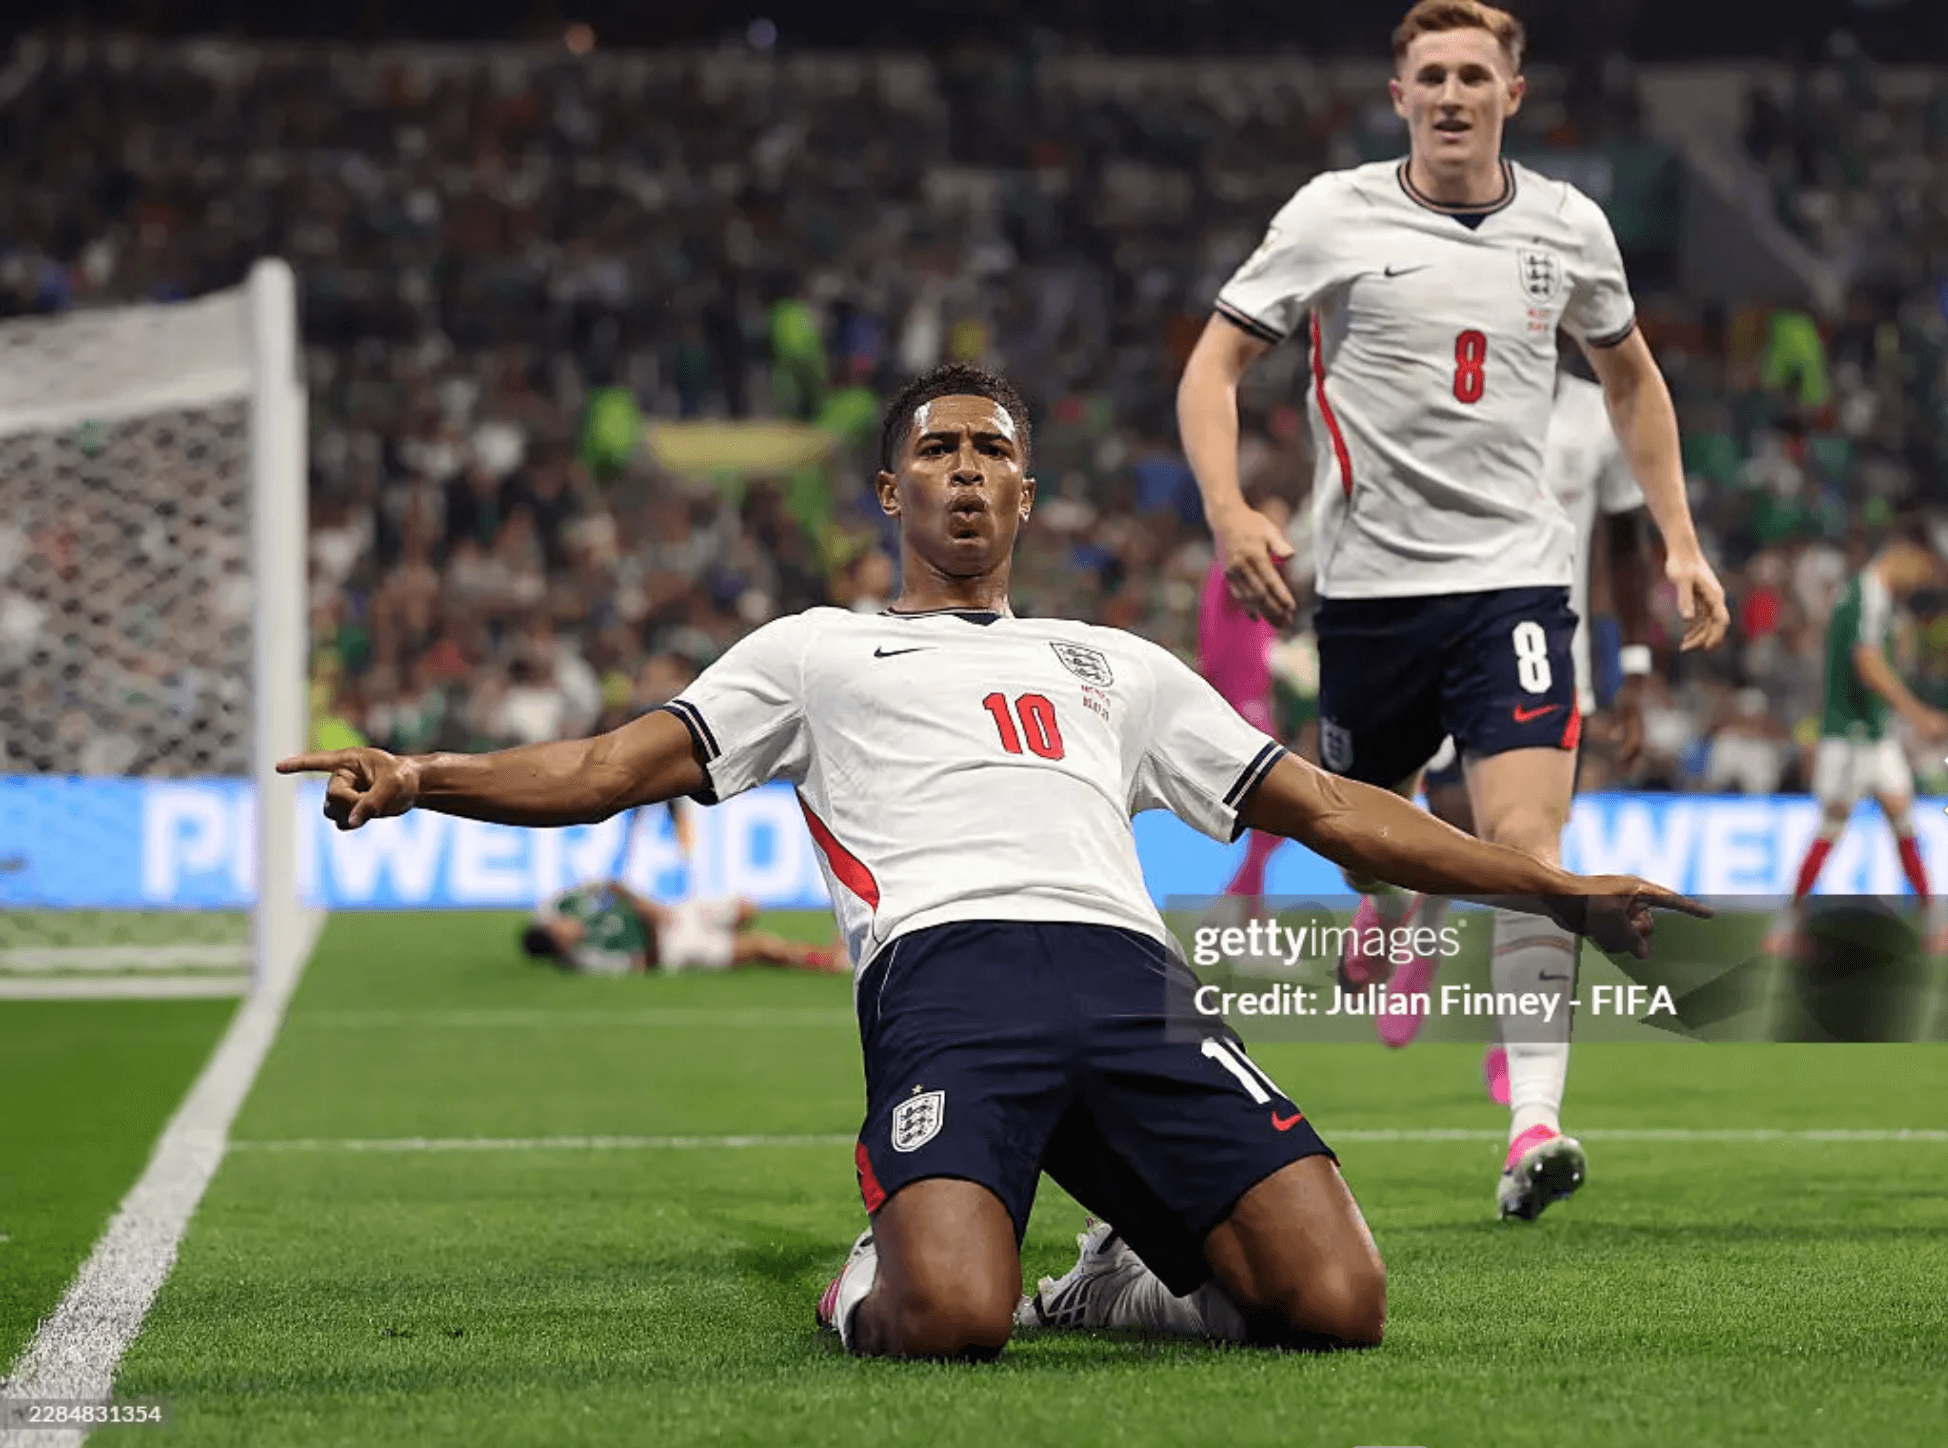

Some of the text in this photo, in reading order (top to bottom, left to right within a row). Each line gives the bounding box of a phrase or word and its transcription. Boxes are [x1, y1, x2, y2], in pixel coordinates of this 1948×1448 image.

[1453, 330, 1488, 404] 8
[1512, 620, 1554, 694] 8
[982, 692, 1065, 761] 10
[143, 790, 828, 898] POWERAD
